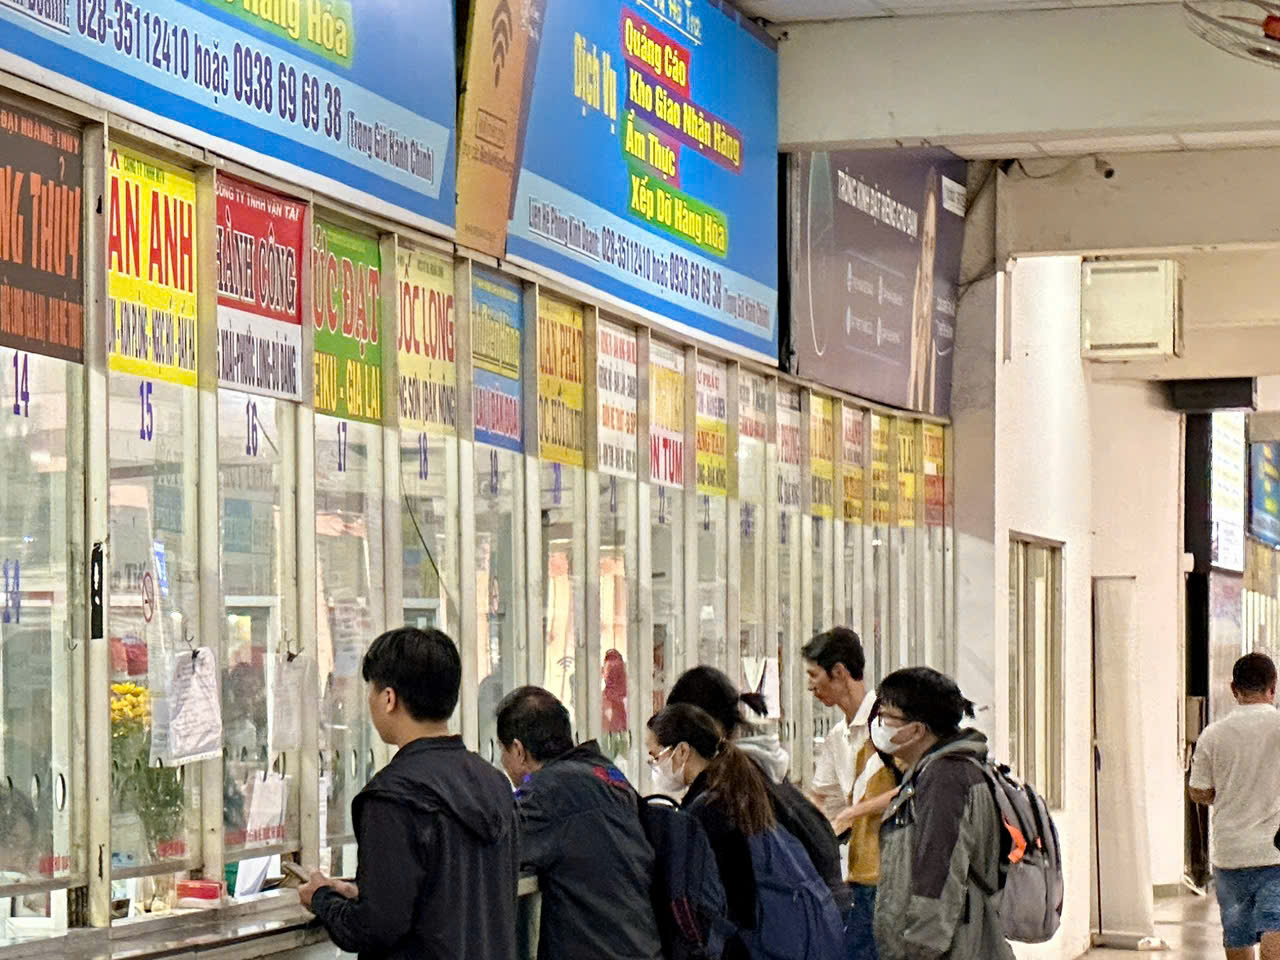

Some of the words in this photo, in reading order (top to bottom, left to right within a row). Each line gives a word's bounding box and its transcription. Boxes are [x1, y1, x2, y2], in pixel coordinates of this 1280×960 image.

[194, 33, 228, 104] hoặc
[233, 42, 273, 113] 0938
[278, 62, 296, 123] 69
[302, 72, 319, 132] 69
[325, 82, 342, 141] 38
[574, 32, 600, 117] Dịch
[602, 51, 617, 134] Vụ
[625, 18, 662, 76] Quảng
[664, 44, 686, 87] Cáo
[625, 109, 646, 160] Ẩm
[647, 133, 676, 180] Thực
[629, 67, 653, 112] Kho
[655, 85, 681, 129] Giao
[683, 102, 711, 149] Nhận
[713, 120, 740, 166] Hàng
[149, 189, 193, 293] ANH
[631, 174, 655, 221] Xếp
[674, 197, 702, 244] Hàng
[258, 222, 296, 314] CÔNG
[669, 252, 688, 297] 0938
[690, 263, 700, 300] 69
[701, 266, 711, 304] 69
[342, 256, 380, 359] ĐẠT
[422, 287, 455, 362] LONG
[13, 351, 29, 418] 14
[140, 381, 153, 441] 15
[347, 359, 362, 417] GIA
[365, 364, 381, 419] LAI
[246, 400, 257, 457] 16
[337, 421, 347, 472] 17
